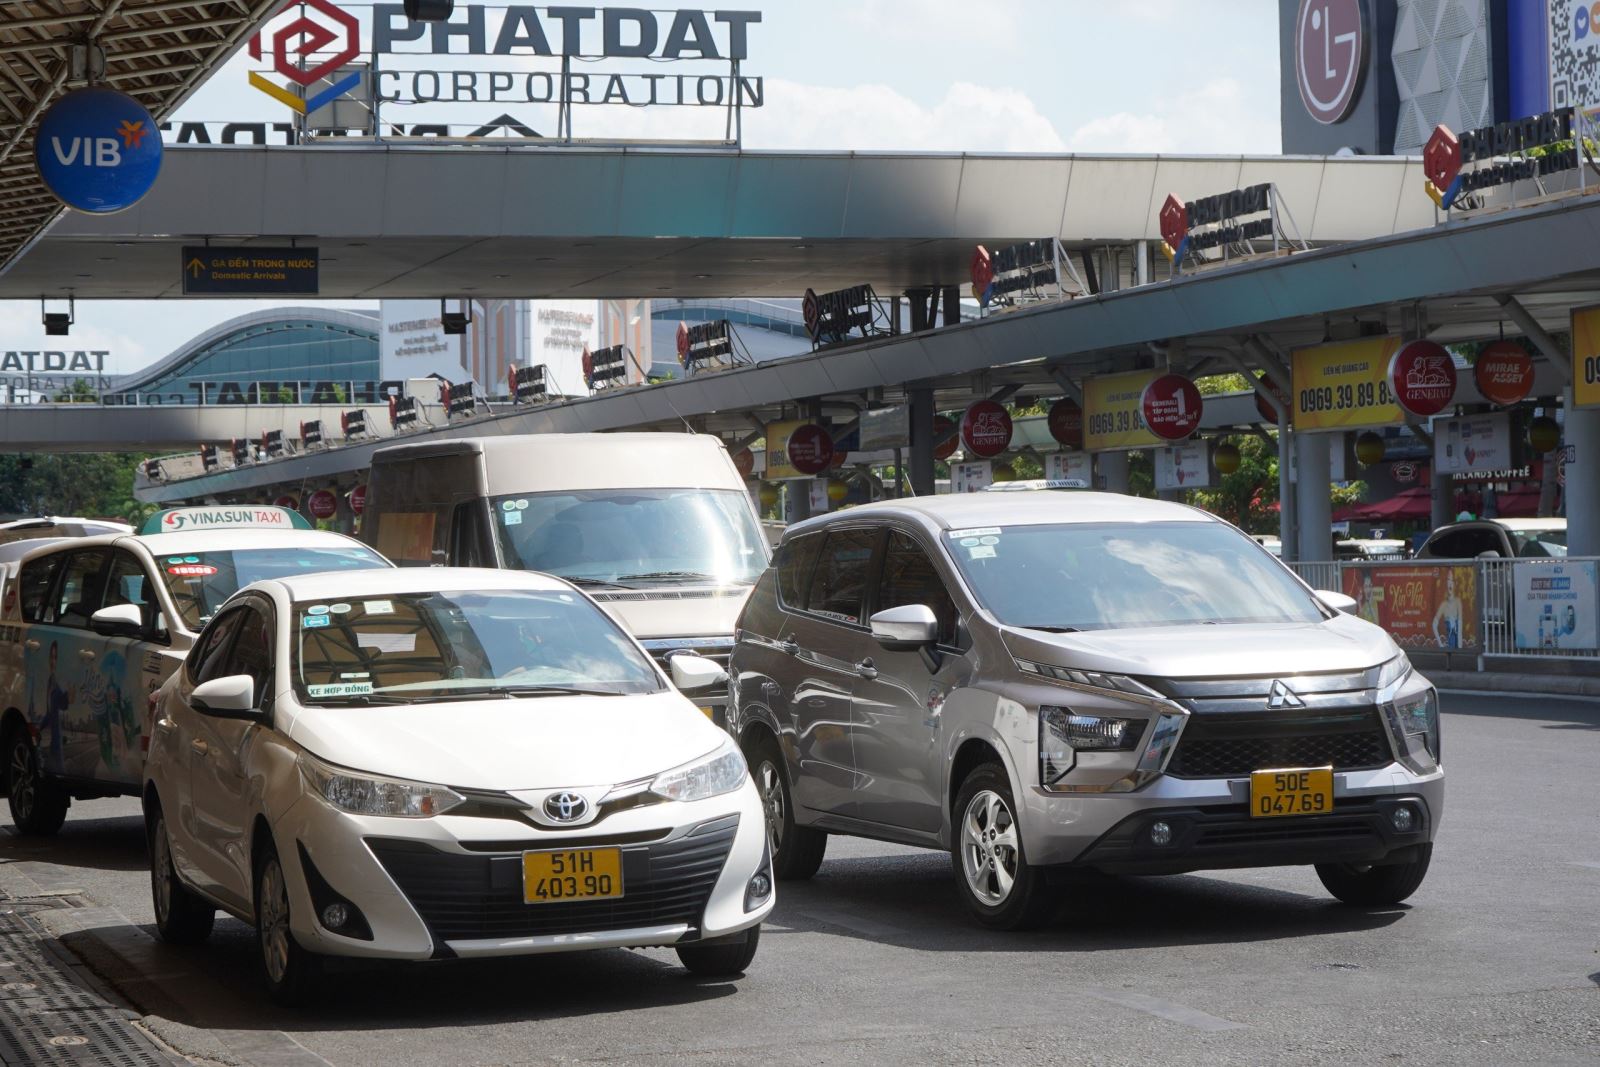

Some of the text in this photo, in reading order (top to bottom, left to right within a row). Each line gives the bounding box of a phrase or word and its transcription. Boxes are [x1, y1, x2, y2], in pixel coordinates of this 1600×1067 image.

[373, 3, 762, 60] PHATDAT
[376, 70, 763, 107] CORPORATION
[51, 136, 121, 167] VIB
[212, 259, 226, 269] GA
[252, 259, 286, 269] TRONG
[212, 271, 286, 280] Domestic Arrivals
[1, 351, 110, 371] ATDAT
[1486, 363, 1520, 374] MIRAE
[1492, 373, 1524, 384] ASSET
[1406, 388, 1452, 400] GENERALI
[189, 511, 282, 525] VINASUN TAXI
[310, 688, 321, 696] XE
[1275, 772, 1310, 792] 50E
[1260, 793, 1325, 814] 047.69
[551, 851, 594, 874] 51H
[535, 874, 612, 899] 403.90
